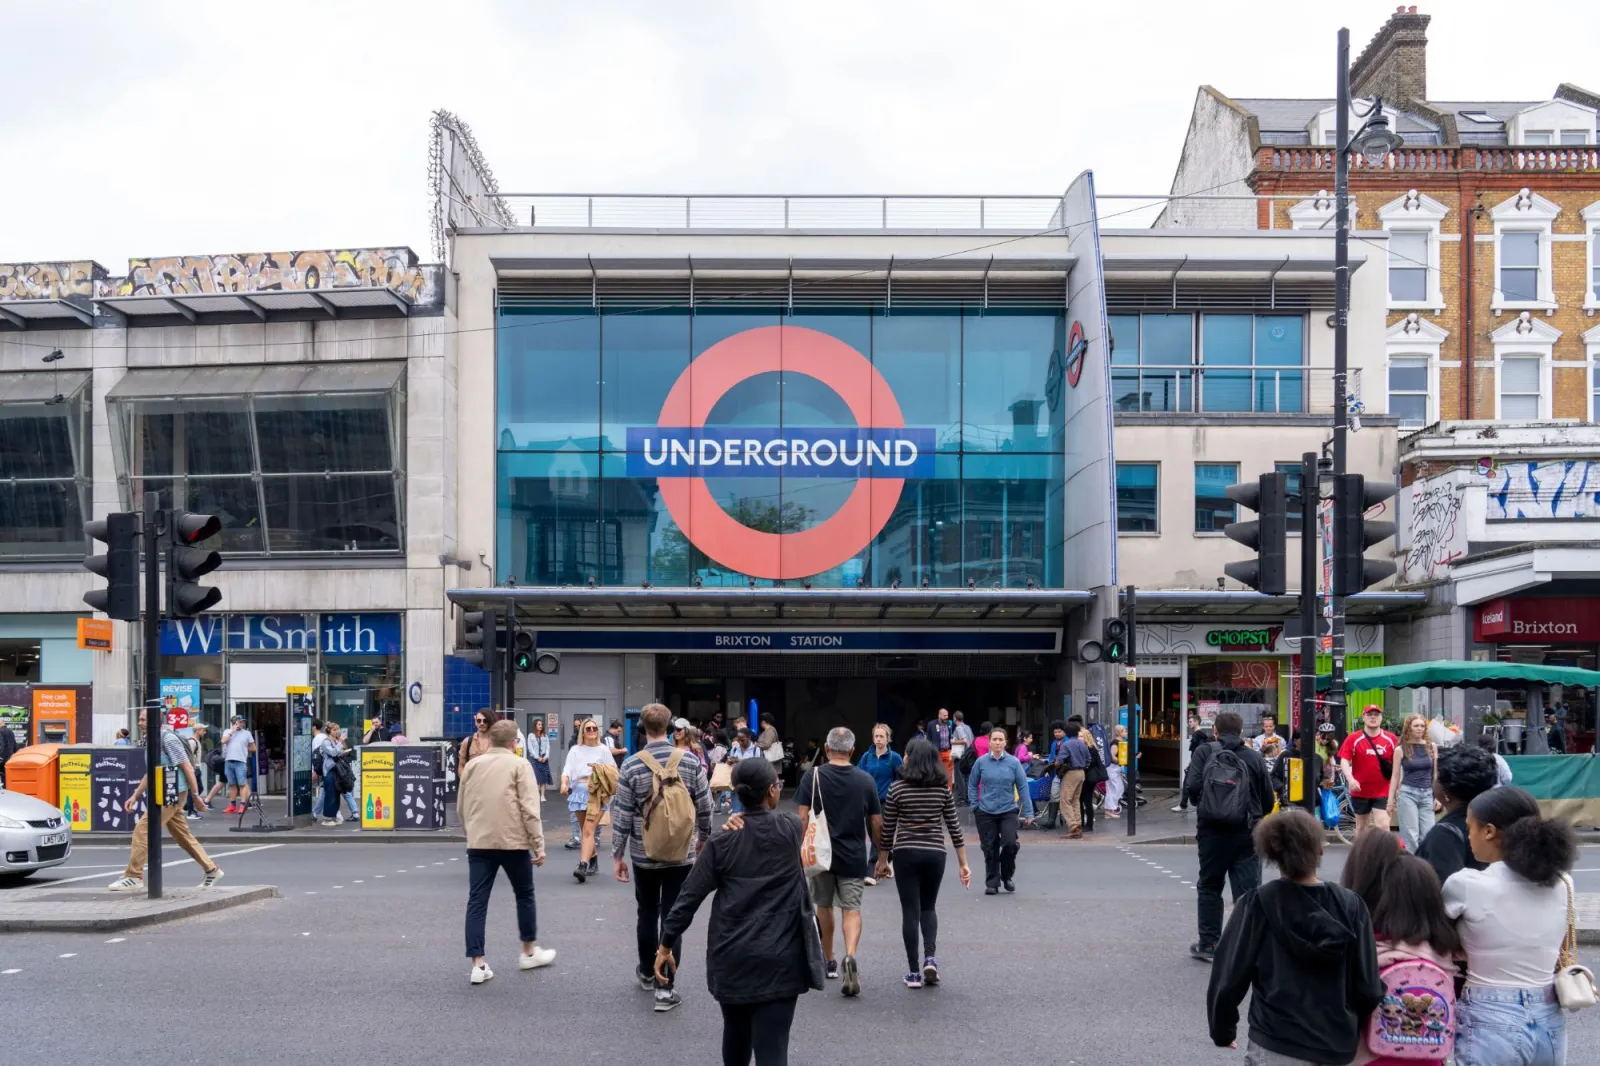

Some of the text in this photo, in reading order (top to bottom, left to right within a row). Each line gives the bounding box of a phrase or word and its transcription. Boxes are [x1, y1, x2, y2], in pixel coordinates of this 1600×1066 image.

[643, 438, 919, 468] UNDERGROUND
[1482, 610, 1504, 625] Iceland
[1512, 620, 1579, 634] Brixton
[174, 614, 379, 655] WHSmith
[714, 635, 843, 647] BRIXTON STATION
[162, 685, 193, 693] REVISE
[38, 701, 72, 709] withdrawals
